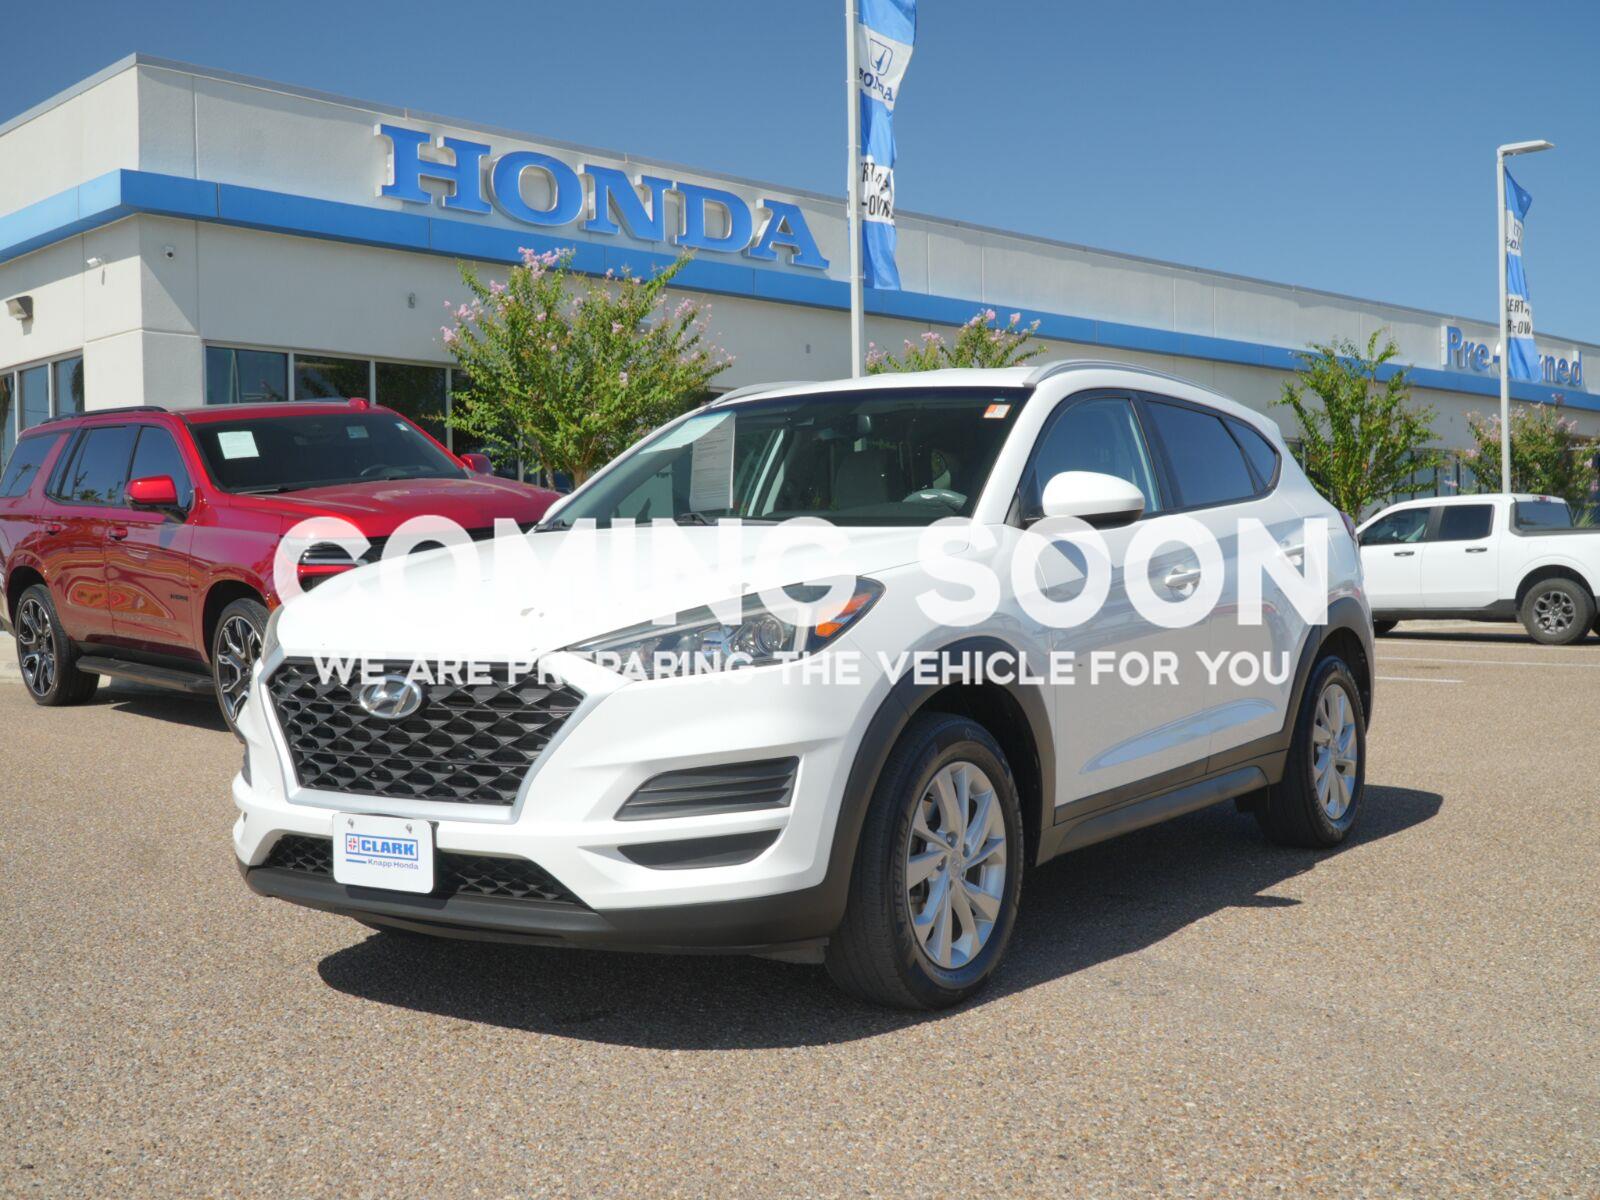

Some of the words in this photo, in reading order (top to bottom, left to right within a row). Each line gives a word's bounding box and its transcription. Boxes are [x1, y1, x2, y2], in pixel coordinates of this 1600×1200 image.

[374, 123, 830, 270] HONDA
[361, 840, 414, 856] CLARK
[368, 859, 393, 869] Knapp
[394, 862, 419, 870] Honda
